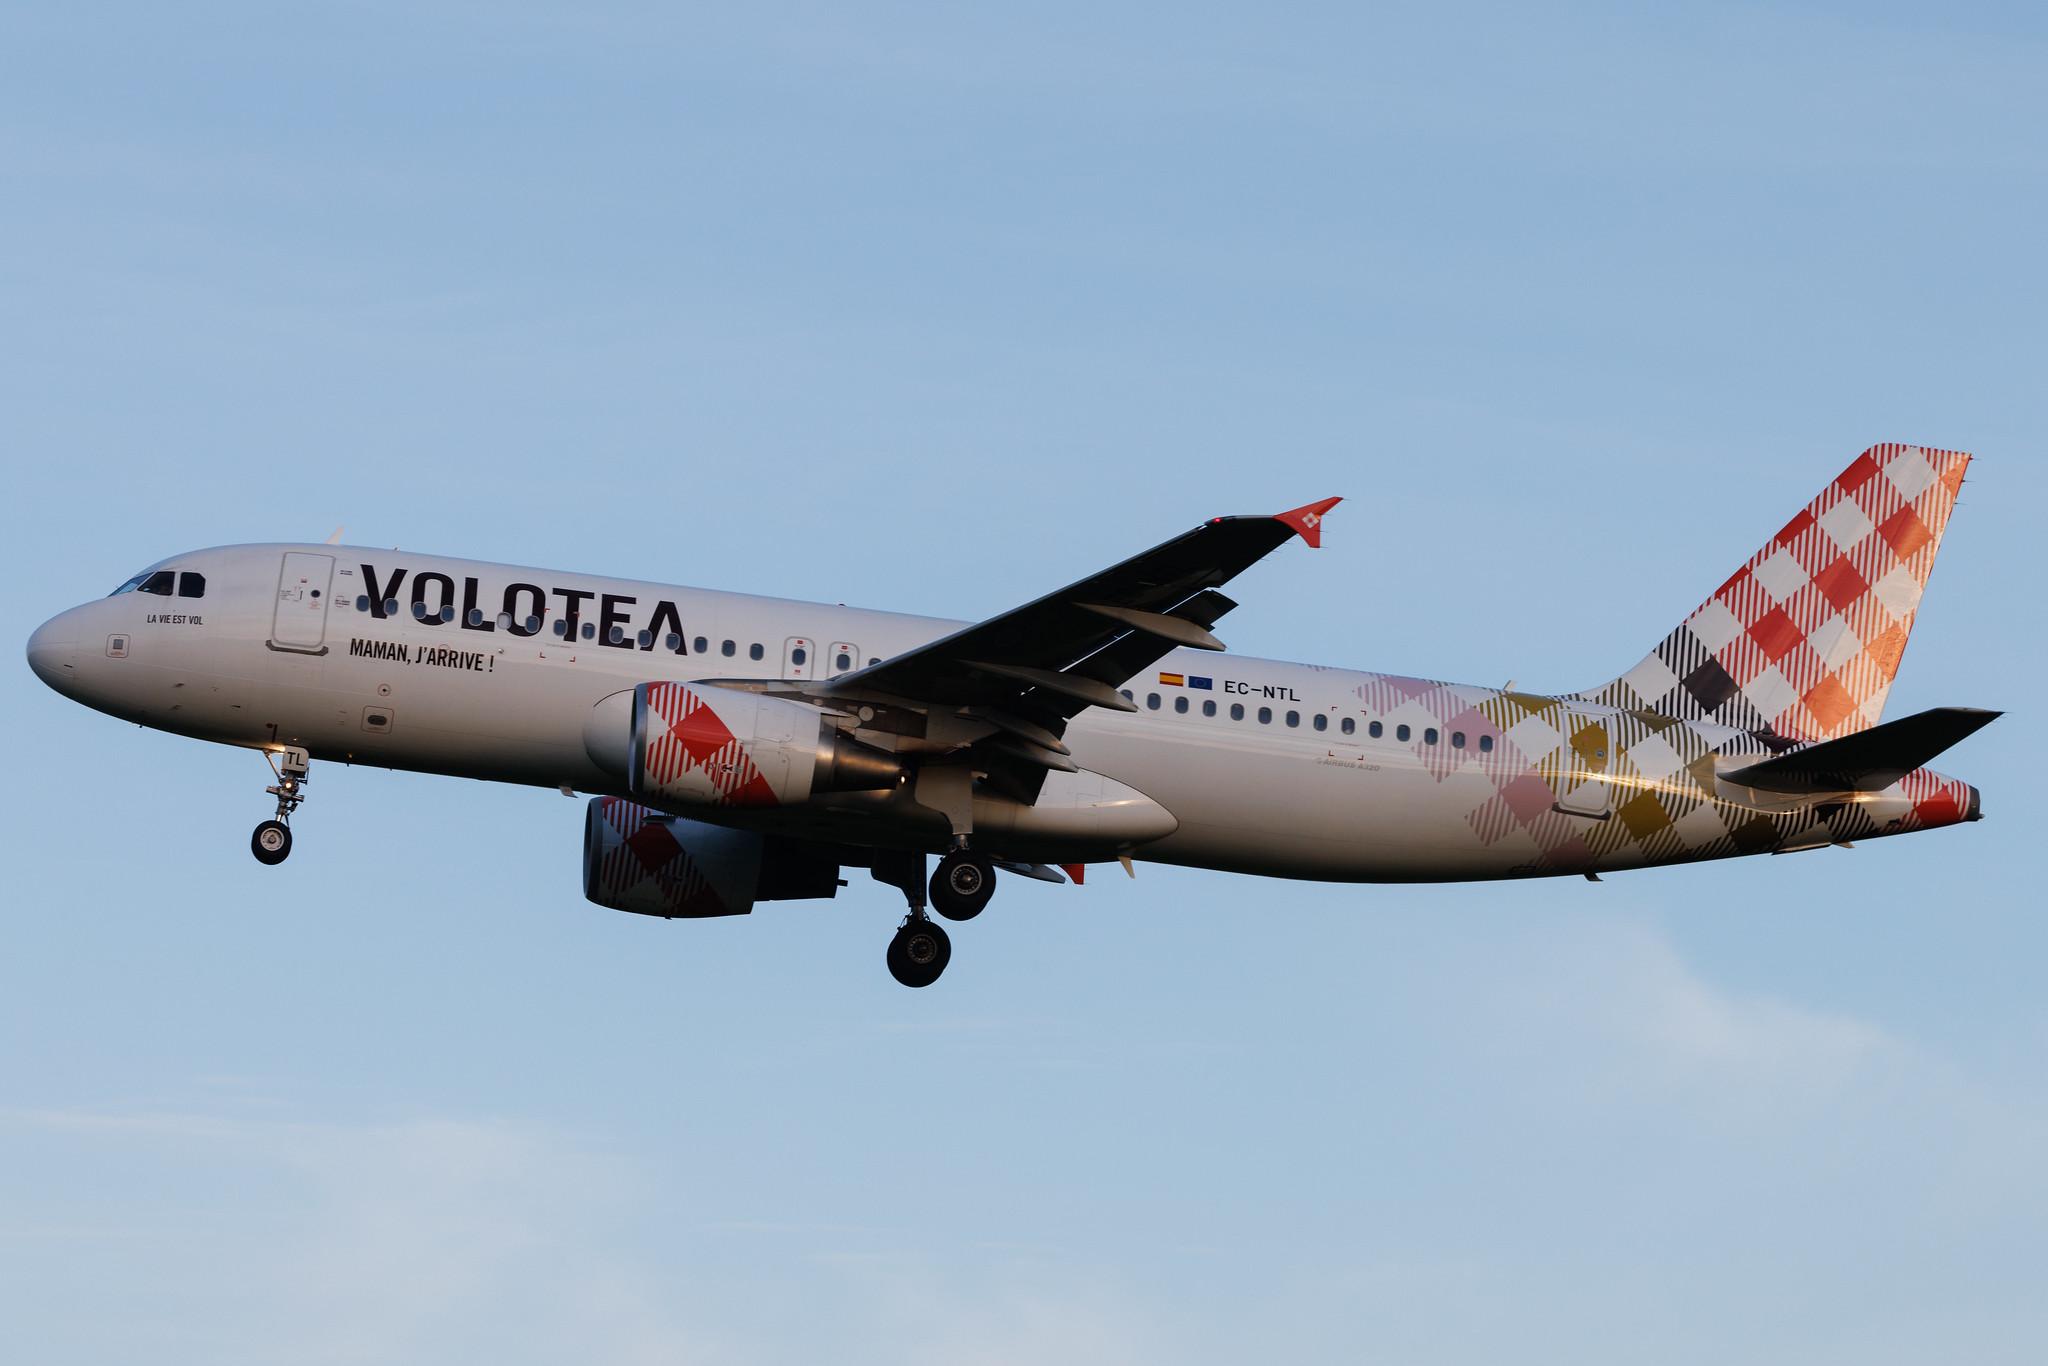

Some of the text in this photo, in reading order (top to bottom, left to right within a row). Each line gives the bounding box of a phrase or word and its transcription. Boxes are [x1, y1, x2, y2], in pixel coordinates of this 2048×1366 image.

[147, 614, 204, 625] LA VIE EST VOL
[360, 563, 688, 657] VOLOTEA
[349, 638, 495, 673] MAMAN, J'ARRIVE !
[1224, 680, 1301, 702] EC-NTL
[287, 751, 305, 766] TL
